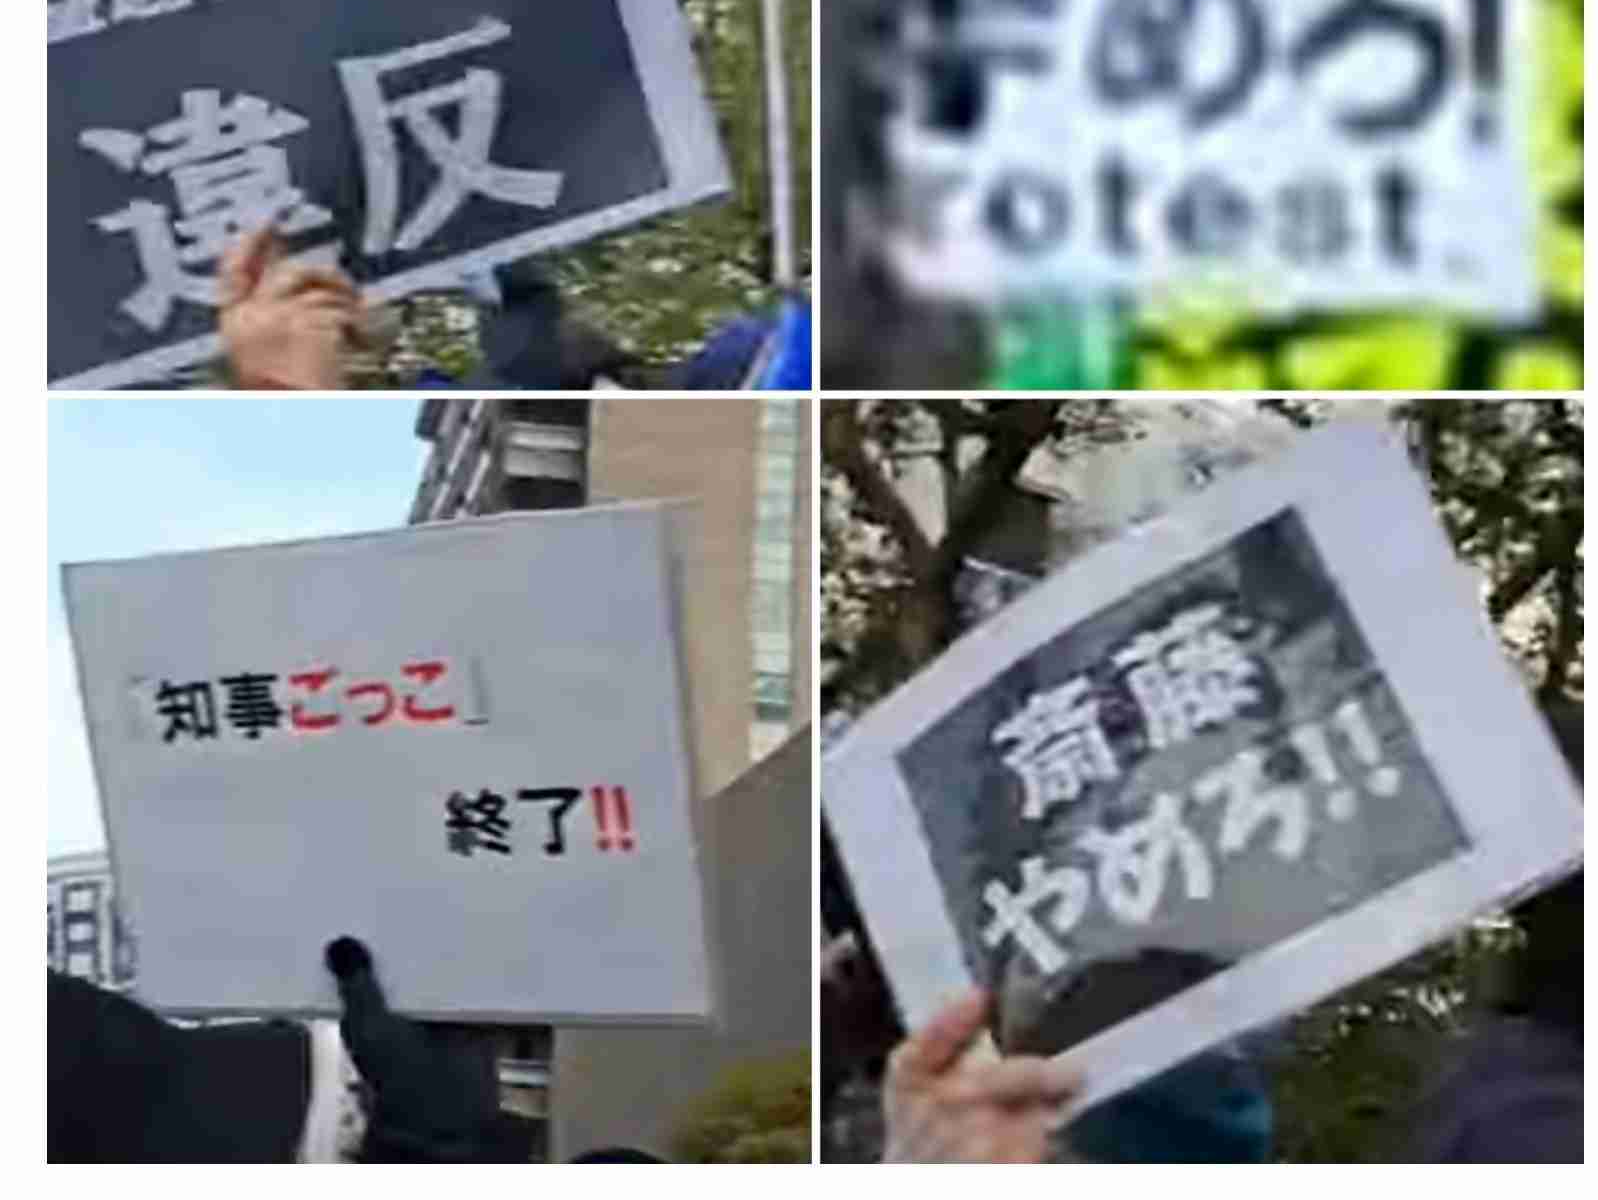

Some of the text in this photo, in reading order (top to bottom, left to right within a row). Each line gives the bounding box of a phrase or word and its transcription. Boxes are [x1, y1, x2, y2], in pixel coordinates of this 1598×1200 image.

[79, 15, 564, 332] 違反
[444, 785, 635, 856] 終了!!
[980, 700, 1400, 975] やめろ!!
